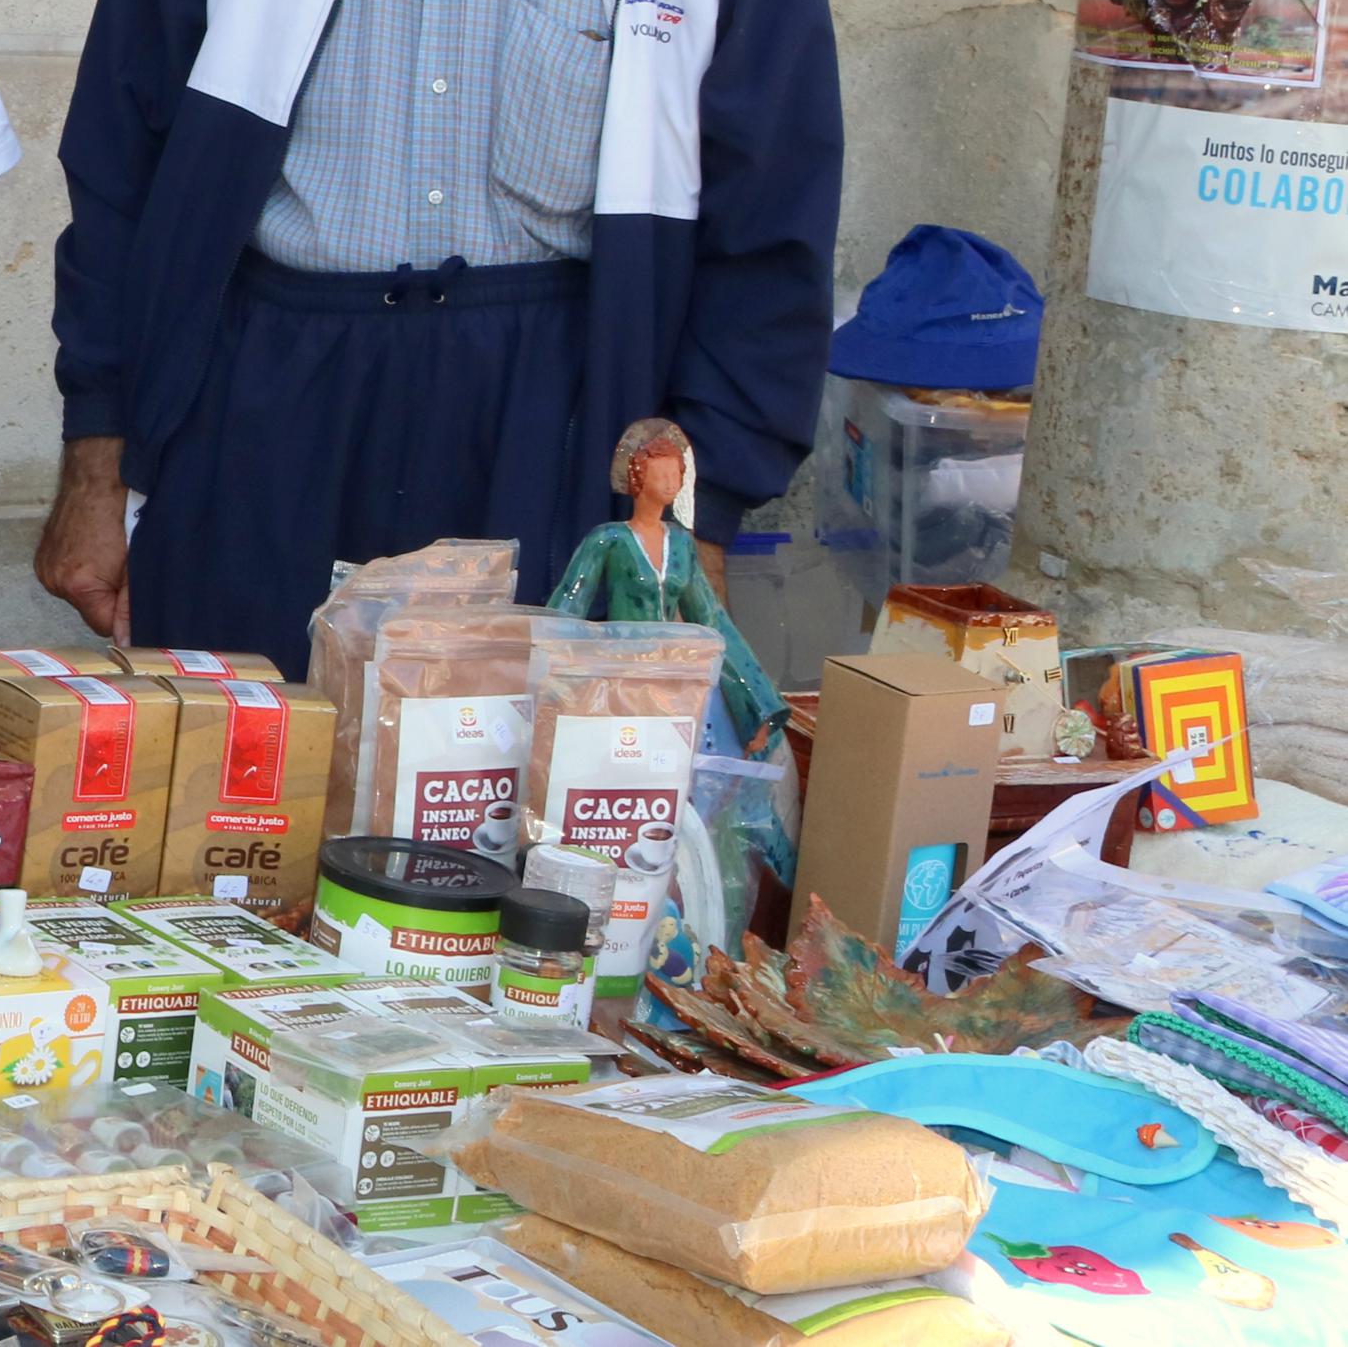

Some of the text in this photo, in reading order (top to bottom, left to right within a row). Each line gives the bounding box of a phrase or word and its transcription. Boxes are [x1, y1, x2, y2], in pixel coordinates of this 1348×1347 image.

[1203, 137, 1274, 164] Juntos lo
[456, 727, 485, 740] ideas
[256, 722, 279, 791] Colombia
[614, 747, 642, 759] ideas
[423, 776, 514, 804] CACAO
[66, 811, 133, 823] comercio justo
[422, 809, 480, 824] INSTAN-
[573, 797, 671, 821] CACAO
[210, 814, 285, 826] comercio justo
[421, 826, 471, 842] TÁNEO
[571, 826, 632, 841] INSTAN-
[60, 837, 130, 869] café
[204, 842, 281, 870] café
[236, 896, 281, 907] Natural
[385, 960, 491, 983] LO QUIERO
[366, 1089, 456, 1110] ETHIQUABLE
[289, 1096, 319, 1125] DEFIENDO
